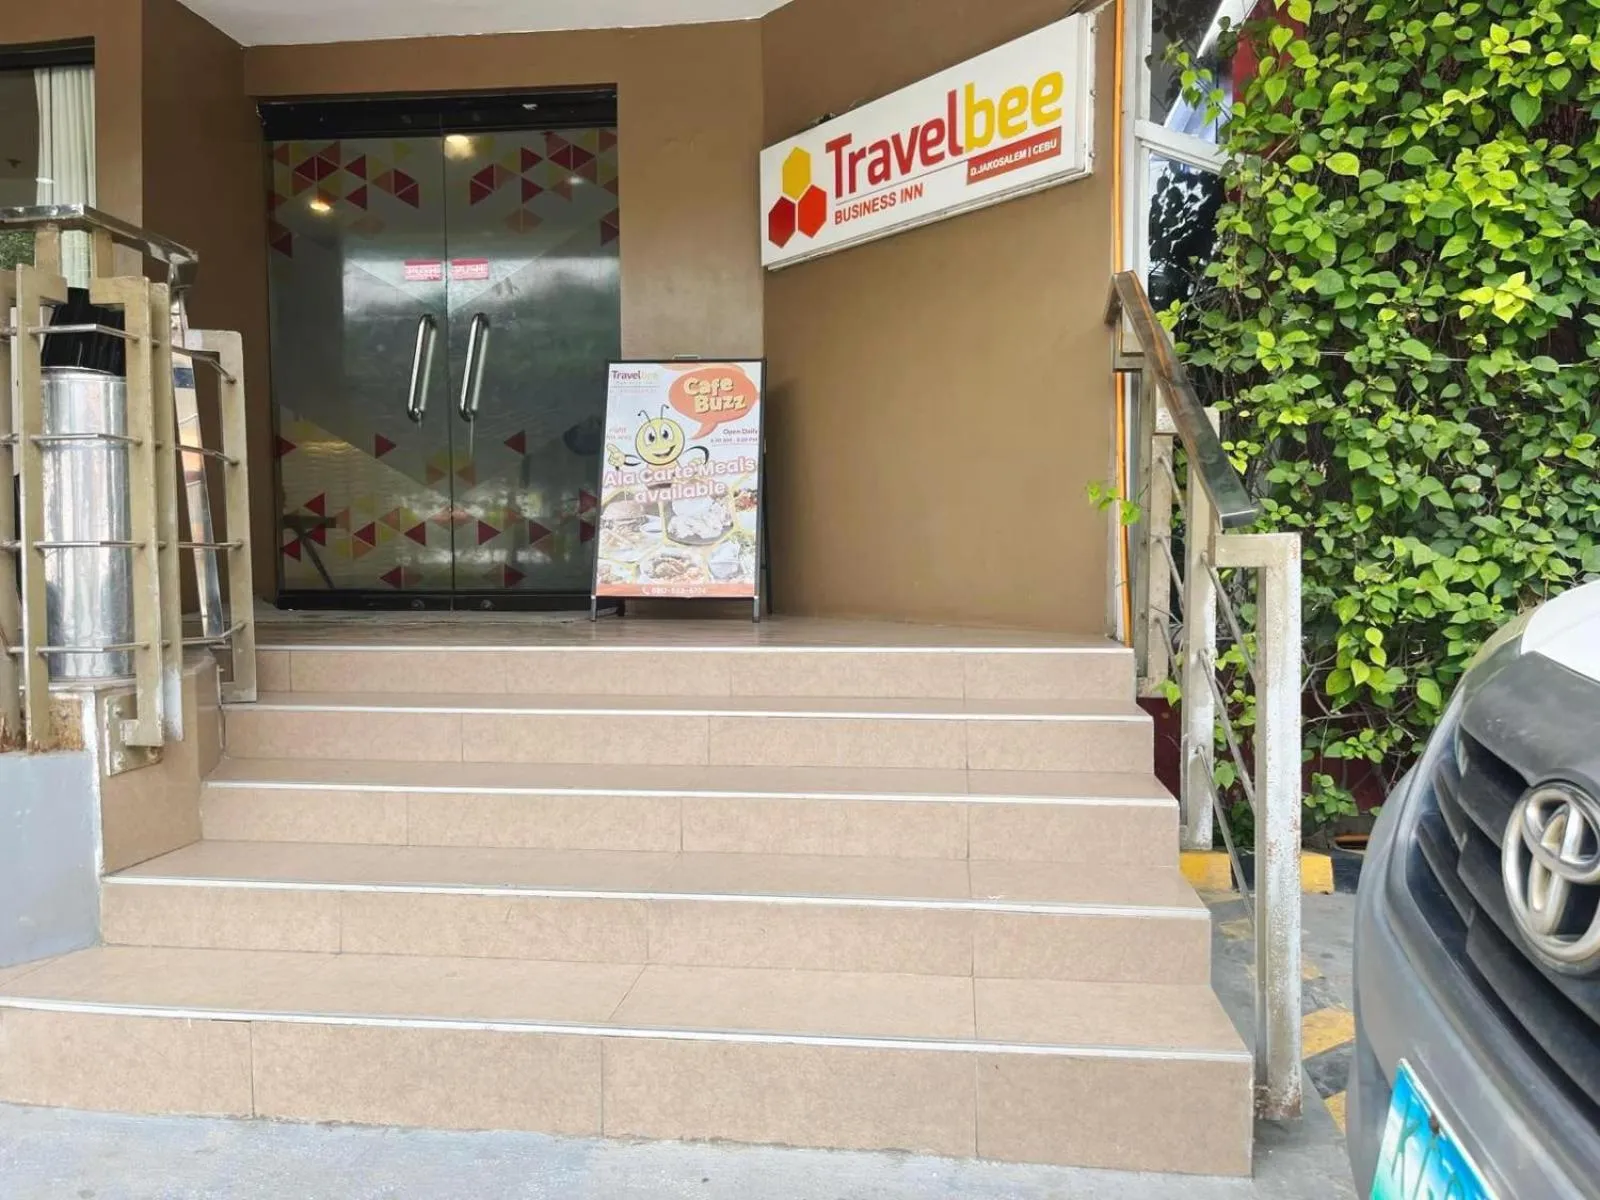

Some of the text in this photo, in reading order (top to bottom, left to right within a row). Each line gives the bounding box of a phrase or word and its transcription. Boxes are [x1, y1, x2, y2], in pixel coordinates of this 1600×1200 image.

[825, 70, 1064, 199] Travelbee
[1032, 137, 1058, 155] CEBU
[834, 183, 924, 226] BUSINESS INN
[683, 377, 734, 397] Cafe
[694, 394, 748, 414] Buzz
[722, 428, 741, 436] Open
[603, 455, 757, 487] Ala Carte Meals
[634, 480, 727, 504] available
